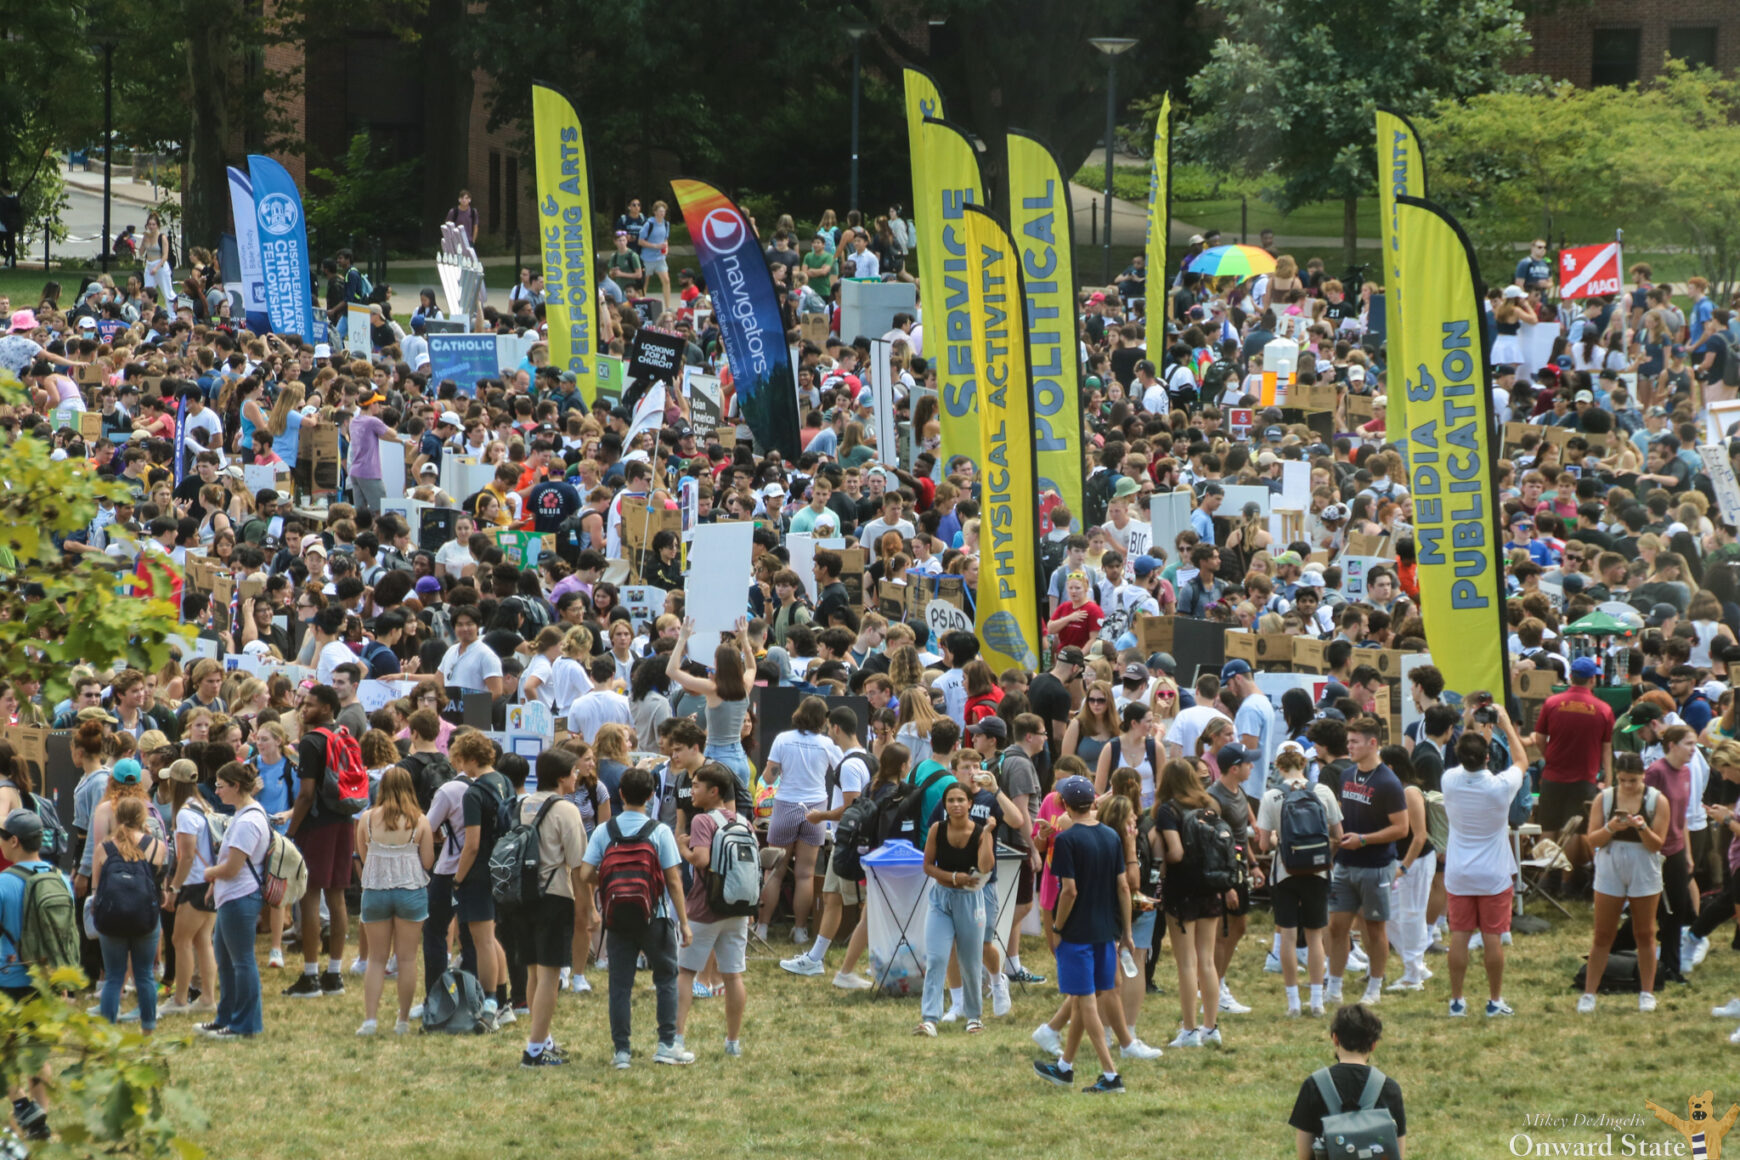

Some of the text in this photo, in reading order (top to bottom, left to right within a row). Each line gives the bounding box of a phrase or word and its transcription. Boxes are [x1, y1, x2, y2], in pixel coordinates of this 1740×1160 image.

[263, 242, 283, 329] FELLOWSHIP
[274, 239, 295, 333] CHRISTIAN
[288, 240, 305, 336] DISCIPLEMAKERS
[541, 194, 564, 305] MUSIC &
[559, 125, 590, 374] PERFORMING ARTS
[641, 343, 675, 357] LOOKING
[711, 290, 722, 316] Penn
[723, 255, 767, 374] navigators
[941, 187, 978, 417] SERVICE
[981, 243, 1009, 408] ACTIVITY
[1023, 179, 1067, 451] POLITICAL
[638, 356, 673, 369] CHURCH?
[645, 350, 660, 359] FOR
[693, 398, 706, 411] Asian
[693, 412, 715, 425] American
[1406, 363, 1446, 565] MEDIA &
[1442, 320, 1489, 610] PUBLICATION
[988, 420, 1017, 600] PHYSICAL
